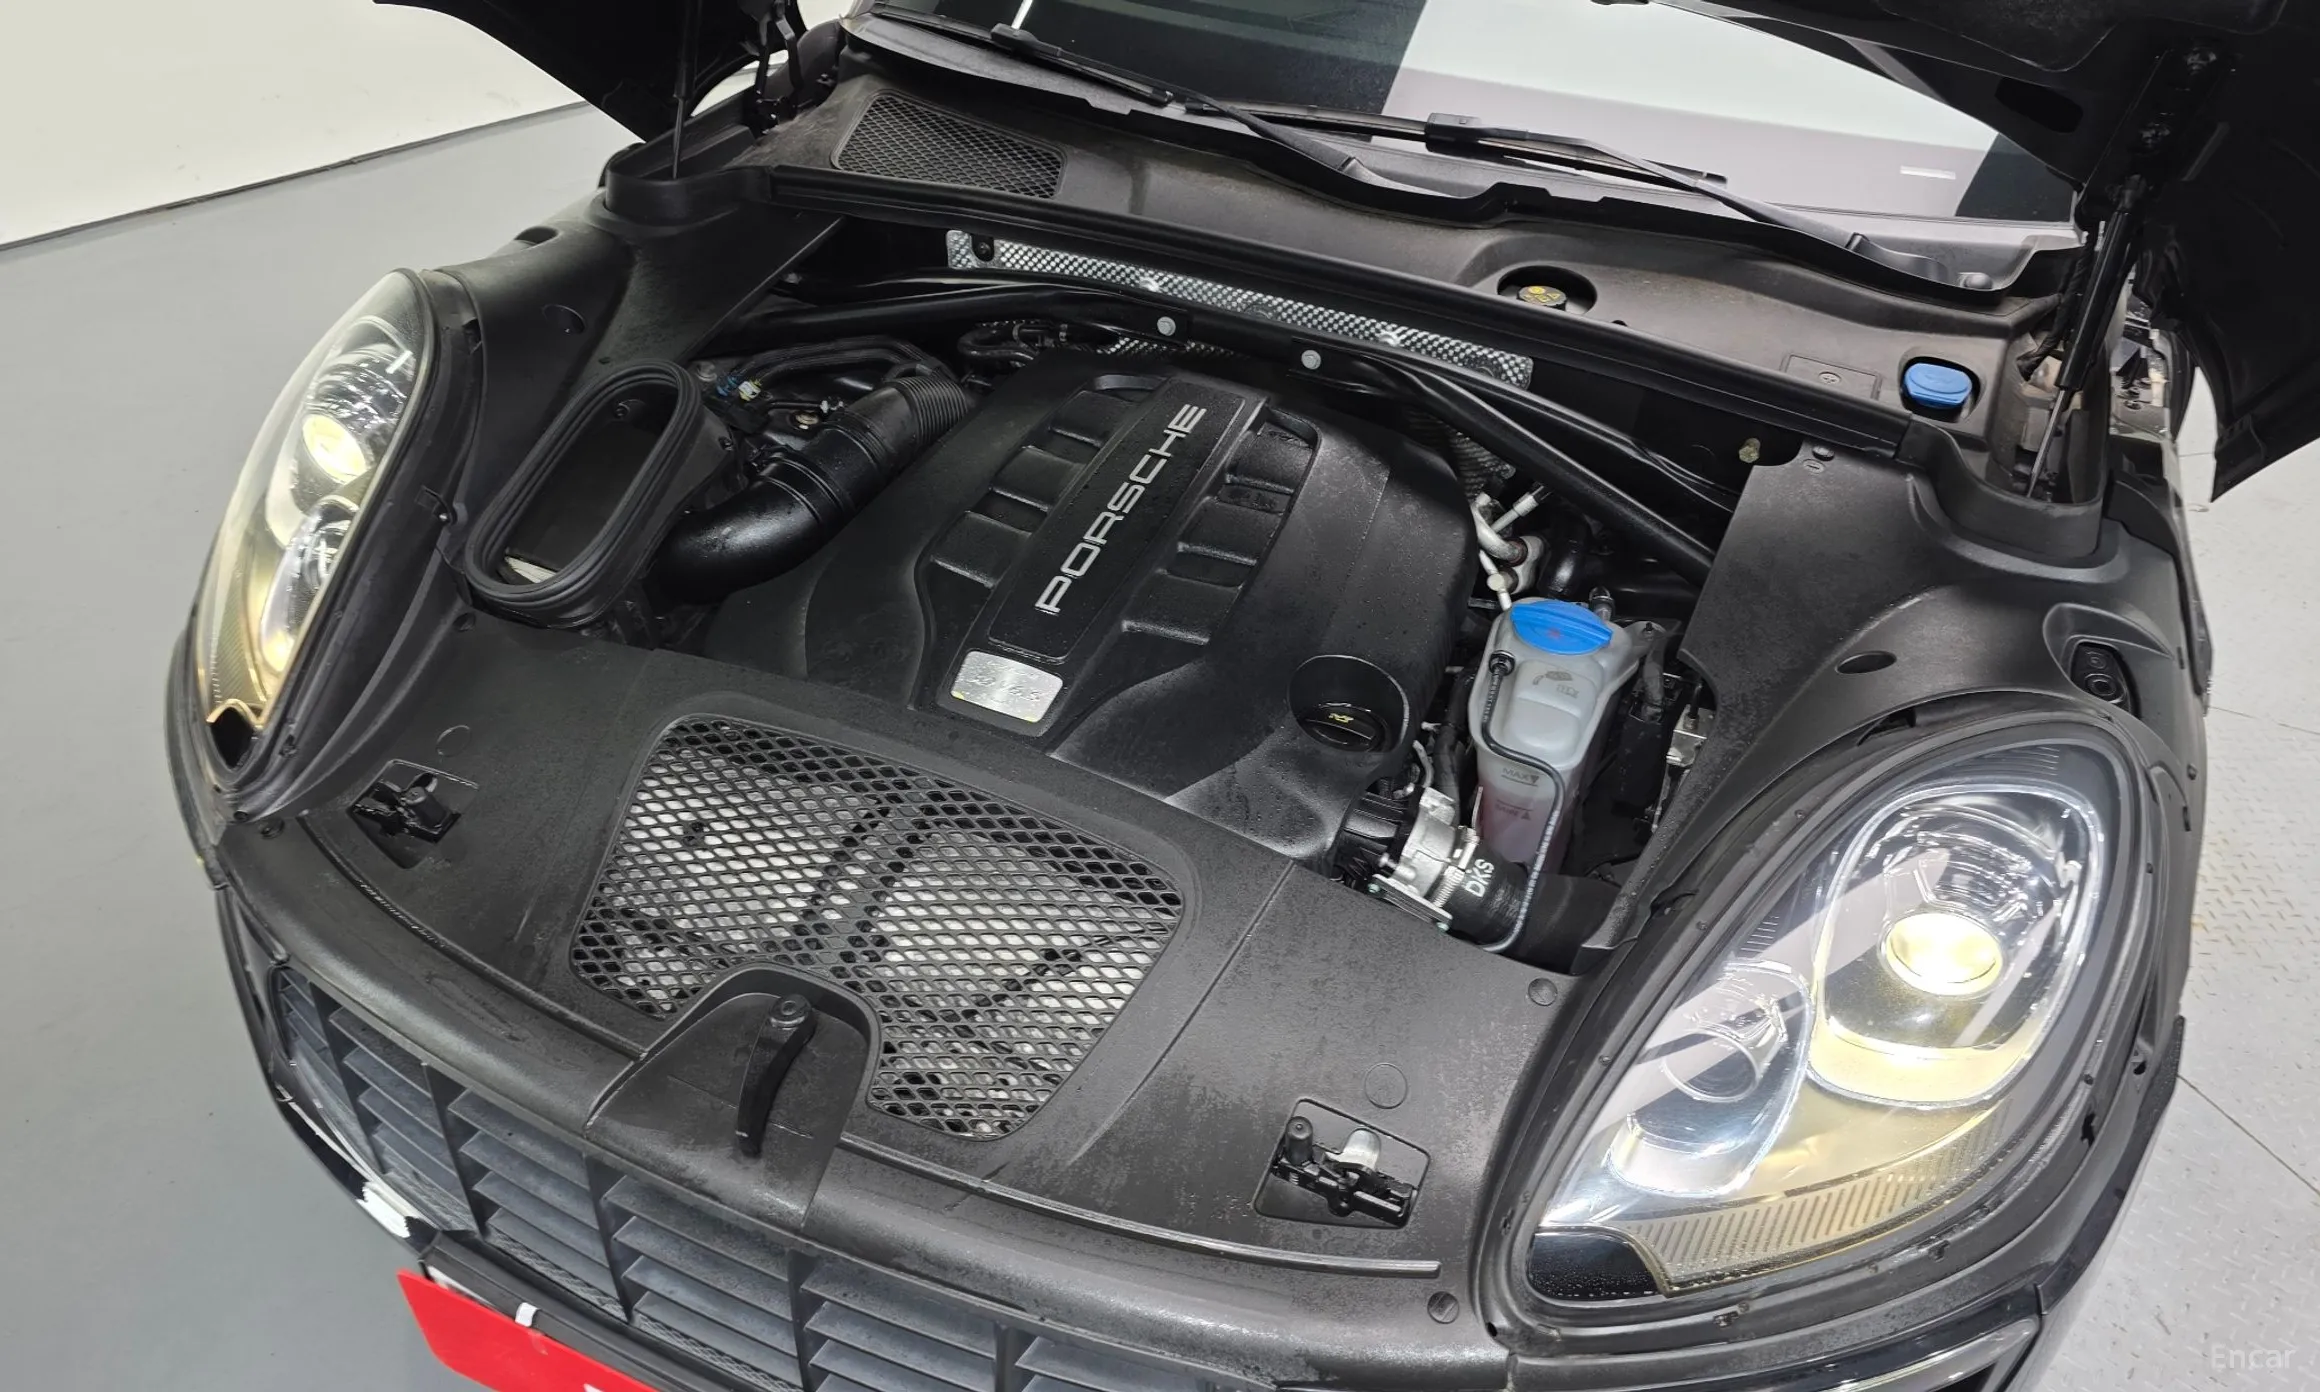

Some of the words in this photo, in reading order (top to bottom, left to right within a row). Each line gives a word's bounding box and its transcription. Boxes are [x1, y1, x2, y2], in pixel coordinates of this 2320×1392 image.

[1034, 403, 1207, 614] PORSCHE
[1502, 767, 1530, 780] MAX
[1463, 858, 1495, 898] DKS
